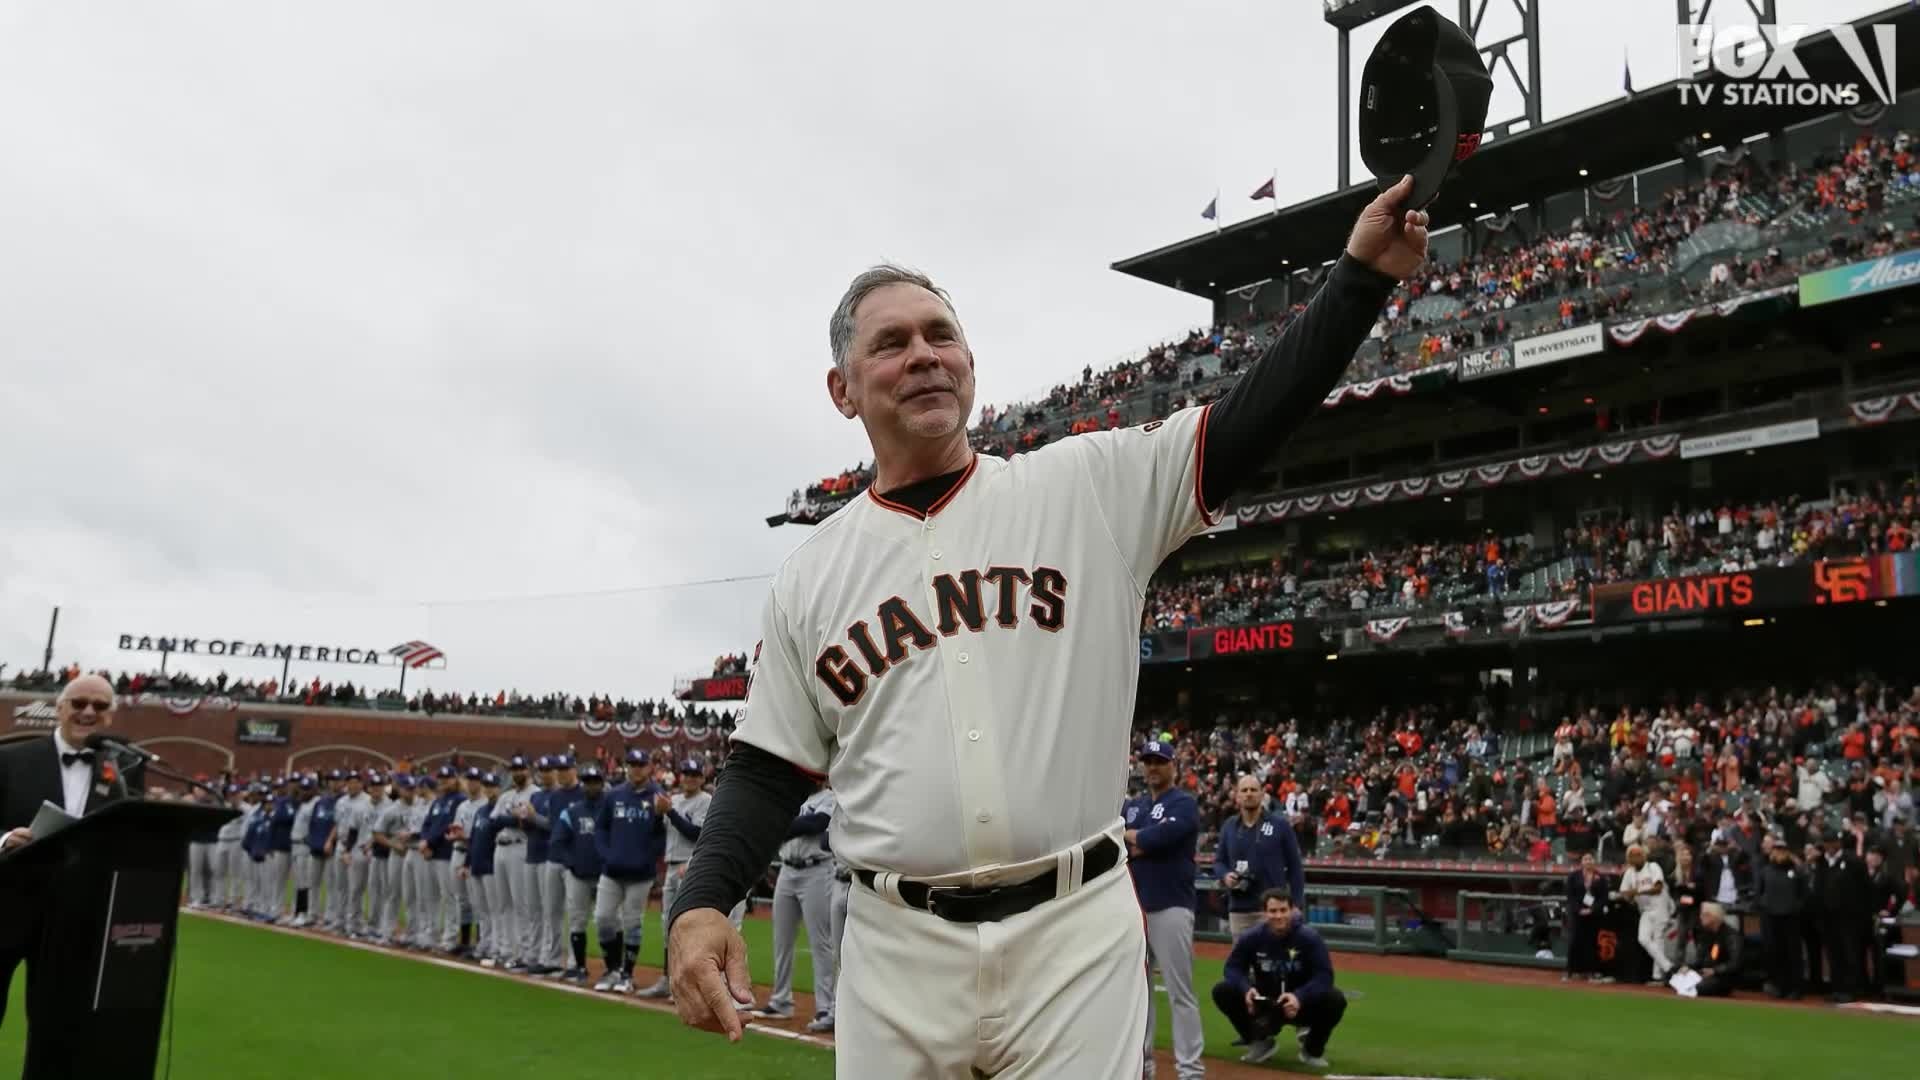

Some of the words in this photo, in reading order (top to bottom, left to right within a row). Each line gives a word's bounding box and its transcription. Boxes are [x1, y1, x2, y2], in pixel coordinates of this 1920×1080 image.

[1462, 350, 1492, 369] NBC
[1521, 346, 1538, 358] WE
[1538, 334, 1598, 354] INVESTIGATE
[1631, 574, 1754, 615] GIANTS
[118, 634, 201, 654] BANK
[208, 639, 247, 656] OF
[251, 642, 381, 666] AMERICA
[816, 565, 1068, 706] GIANTS
[1214, 622, 1294, 655] GIANTS
